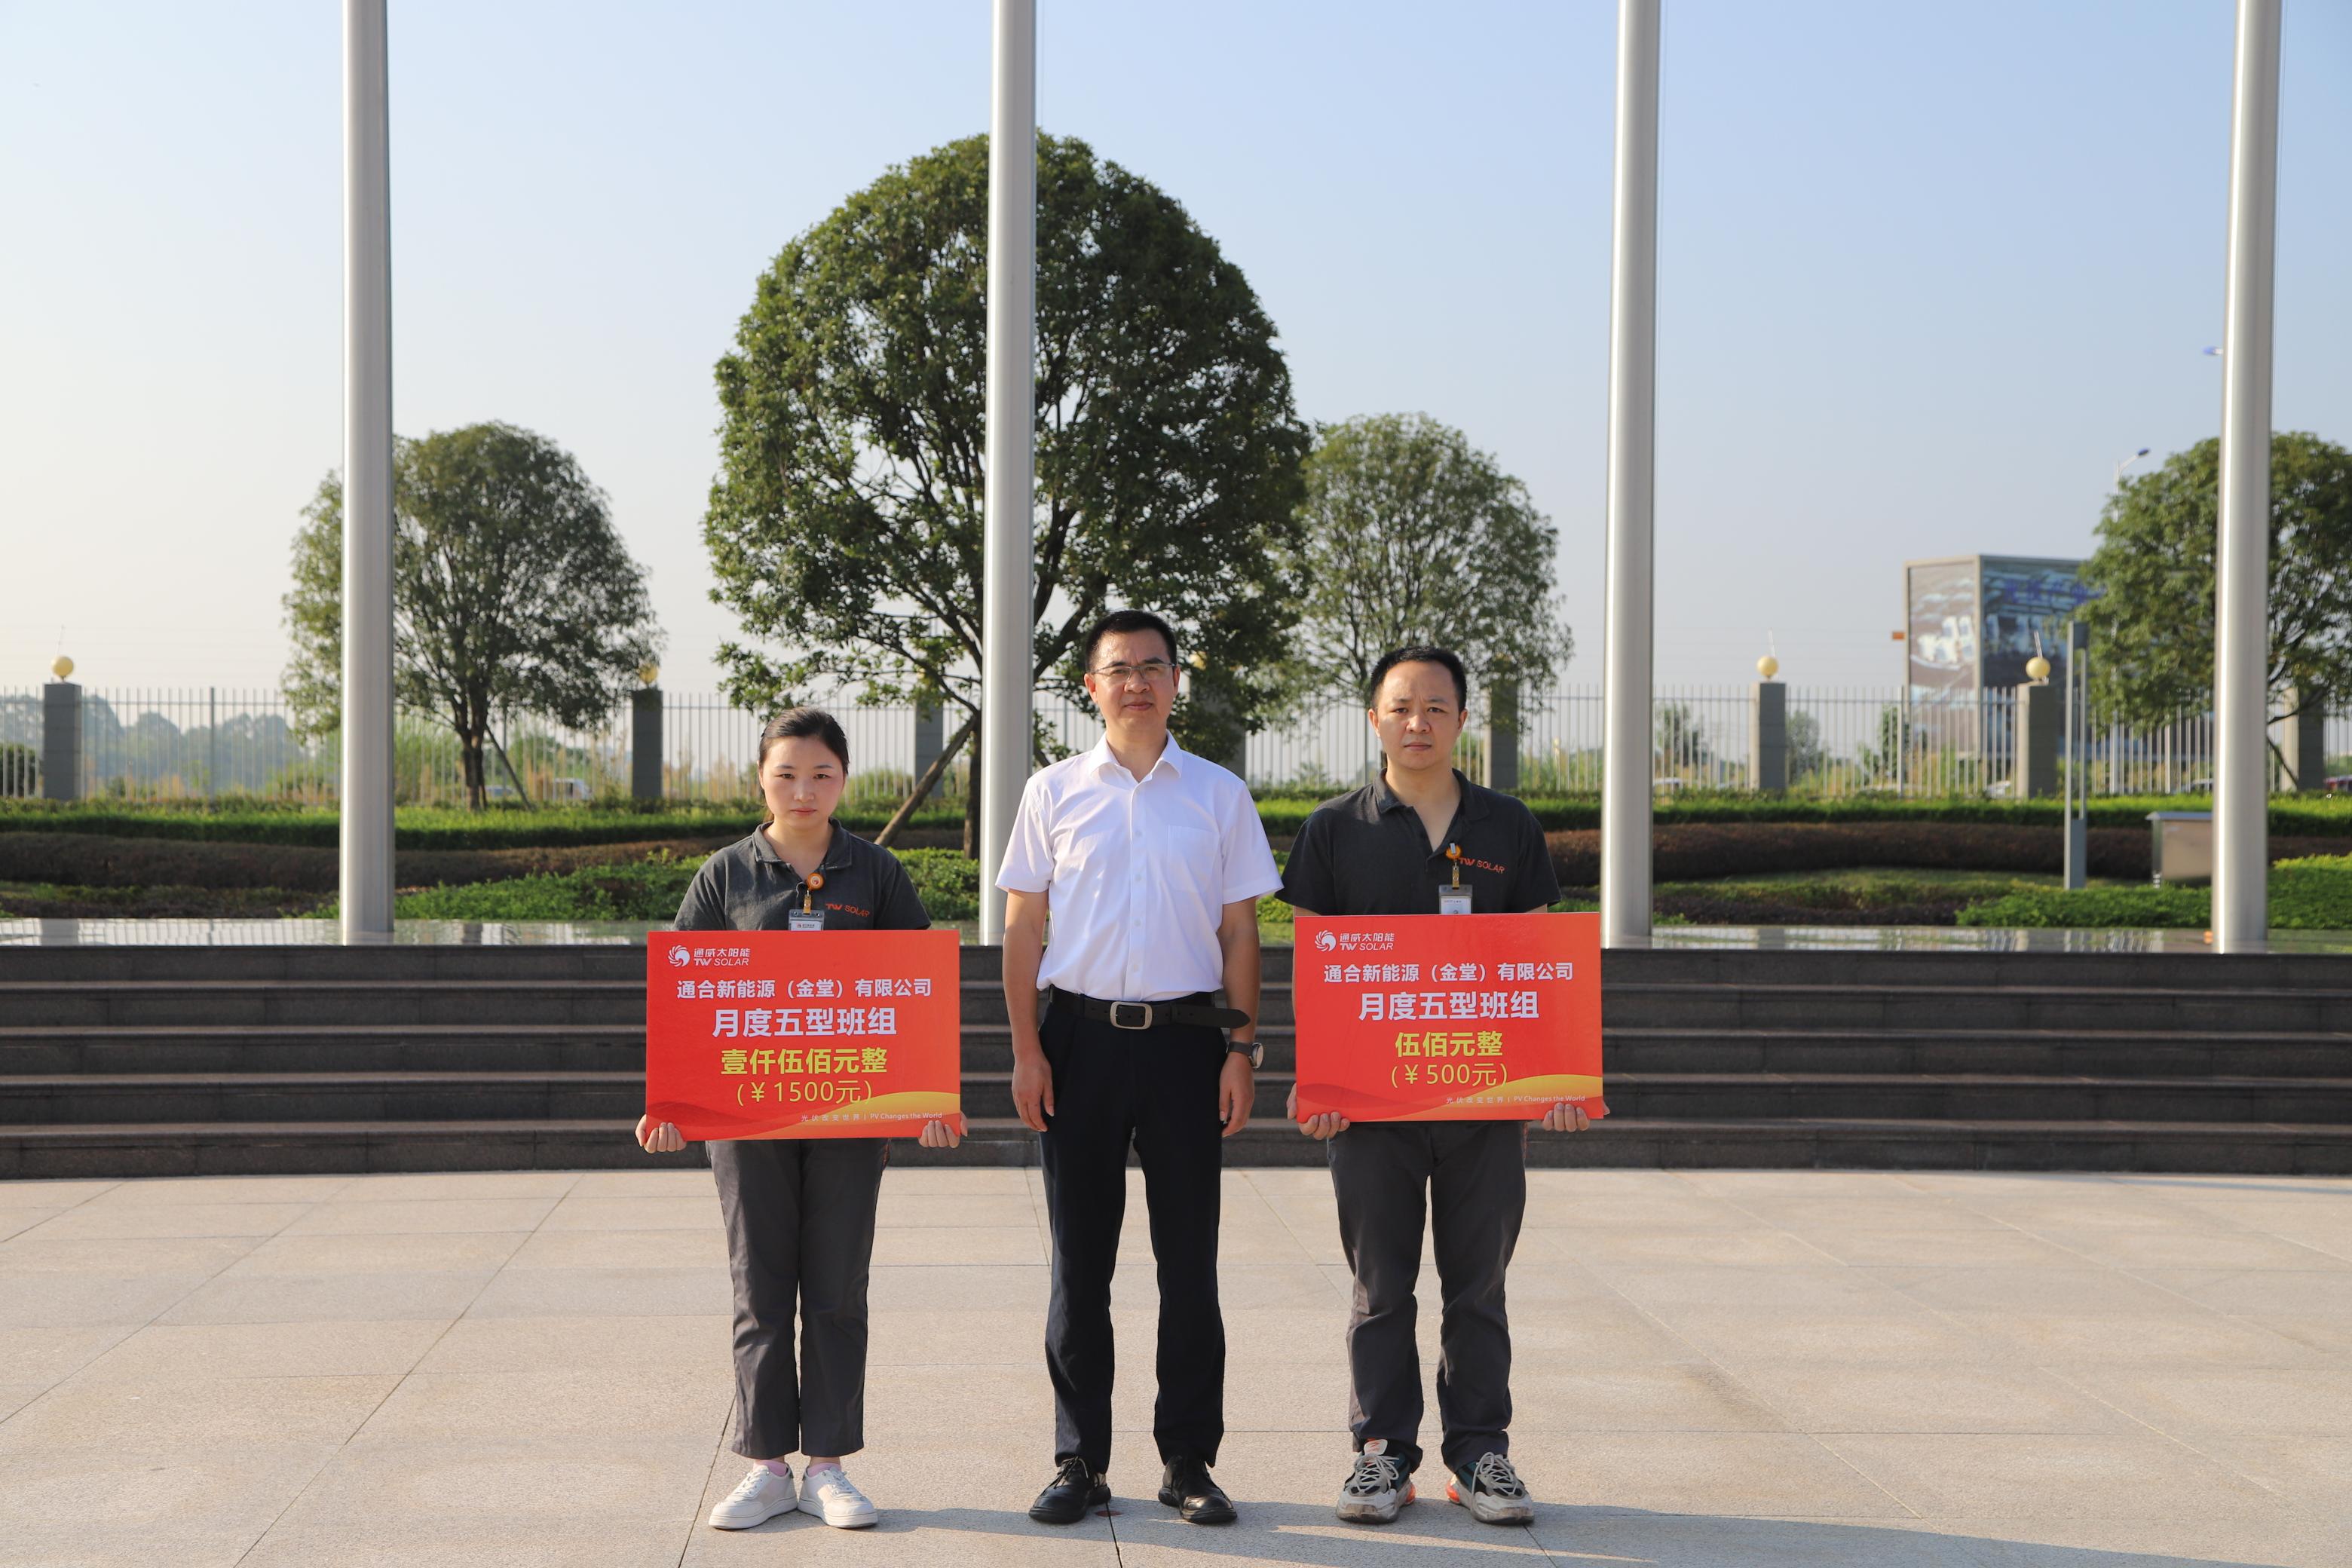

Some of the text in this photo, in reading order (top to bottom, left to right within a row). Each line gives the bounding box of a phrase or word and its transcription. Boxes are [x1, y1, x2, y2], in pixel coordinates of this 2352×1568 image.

[1458, 857, 1506, 874] TW SOLAR
[825, 902, 844, 911] TW
[1339, 933, 1395, 942] 通威太阳能
[693, 947, 751, 958] 通威太阳能
[1339, 942, 1394, 951] TW SOLAR
[693, 957, 750, 966] TW SOLAR
[1324, 962, 1574, 982] 通合新能源（金堂）有限公司
[677, 978, 932, 1000] 通合新能源（金堂）有限公司
[1358, 991, 1539, 1021] 月度五型班组
[712, 1006, 897, 1038] 月度五型班组
[1395, 1031, 1503, 1058] 伍佰元整
[721, 1047, 887, 1076] 壹仟伍佰元整
[880, 1113, 909, 1121] Changes
